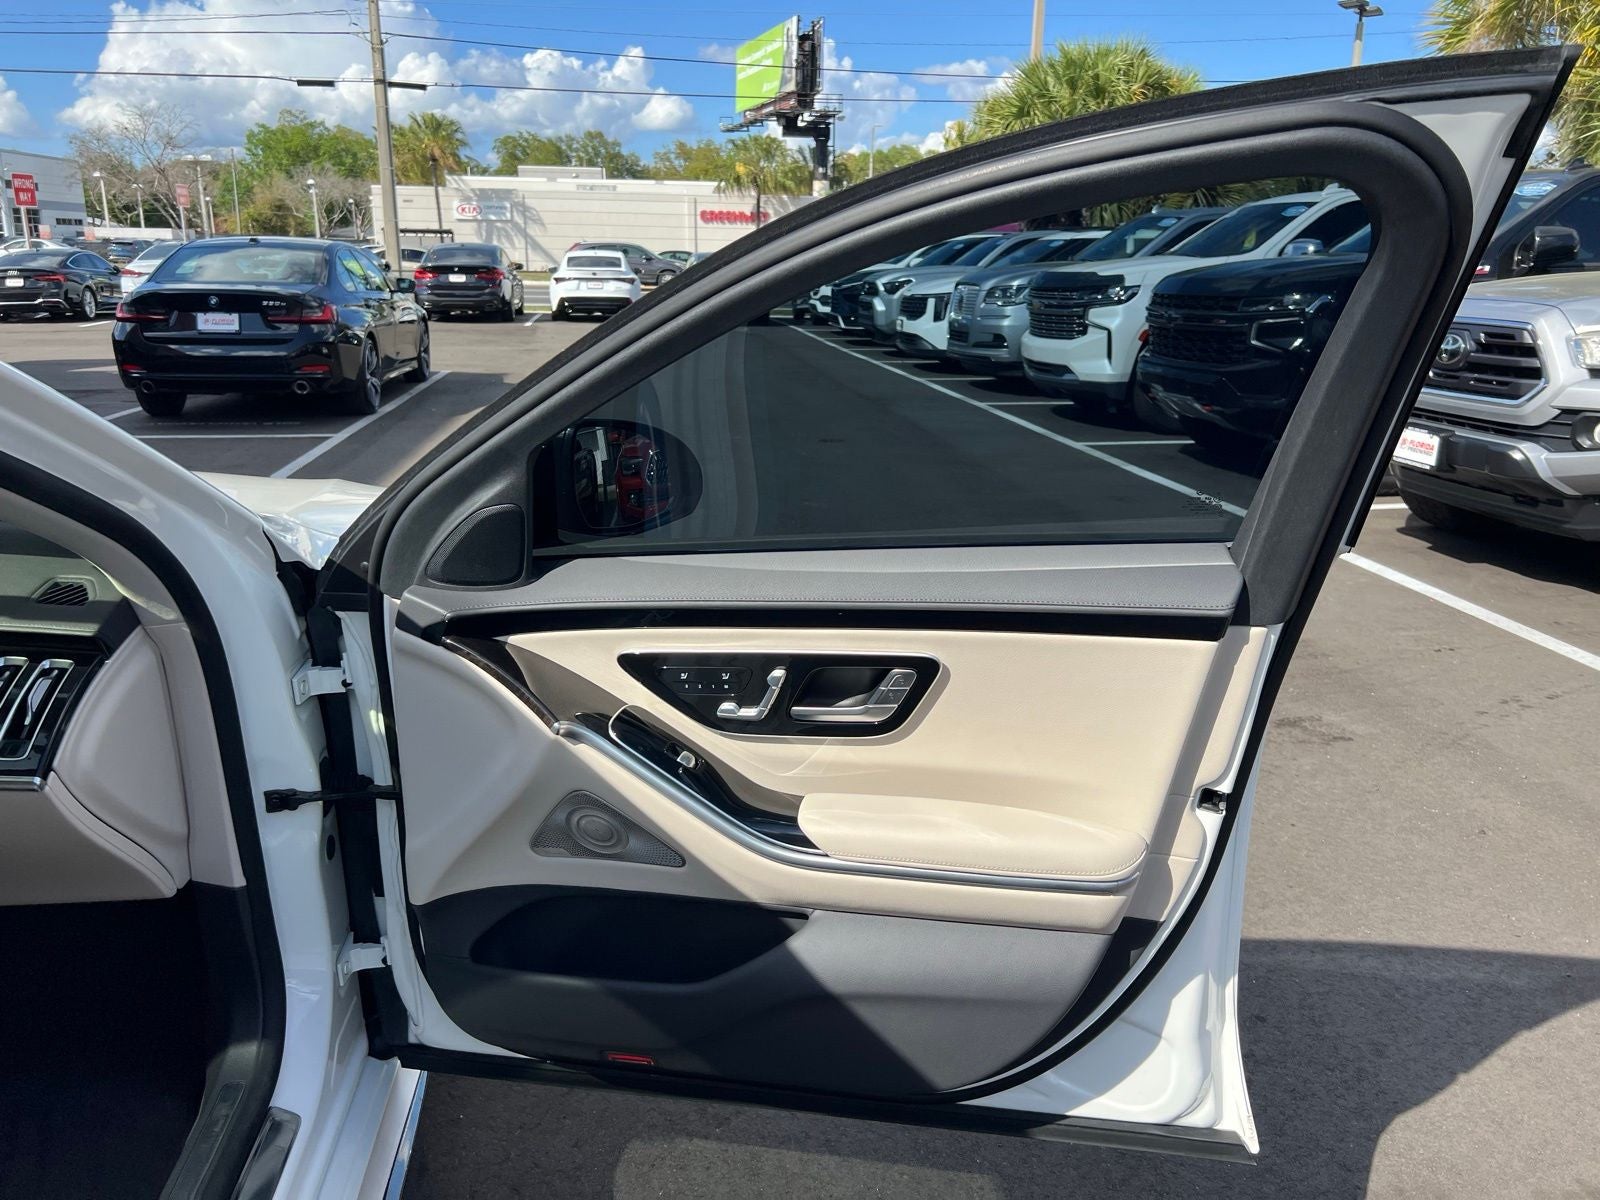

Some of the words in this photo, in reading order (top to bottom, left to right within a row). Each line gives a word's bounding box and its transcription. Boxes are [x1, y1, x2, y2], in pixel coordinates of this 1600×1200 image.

[13, 178, 34, 190] WRONG
[18, 191, 32, 202] WAY
[1408, 440, 1435, 451] FLORIDA
